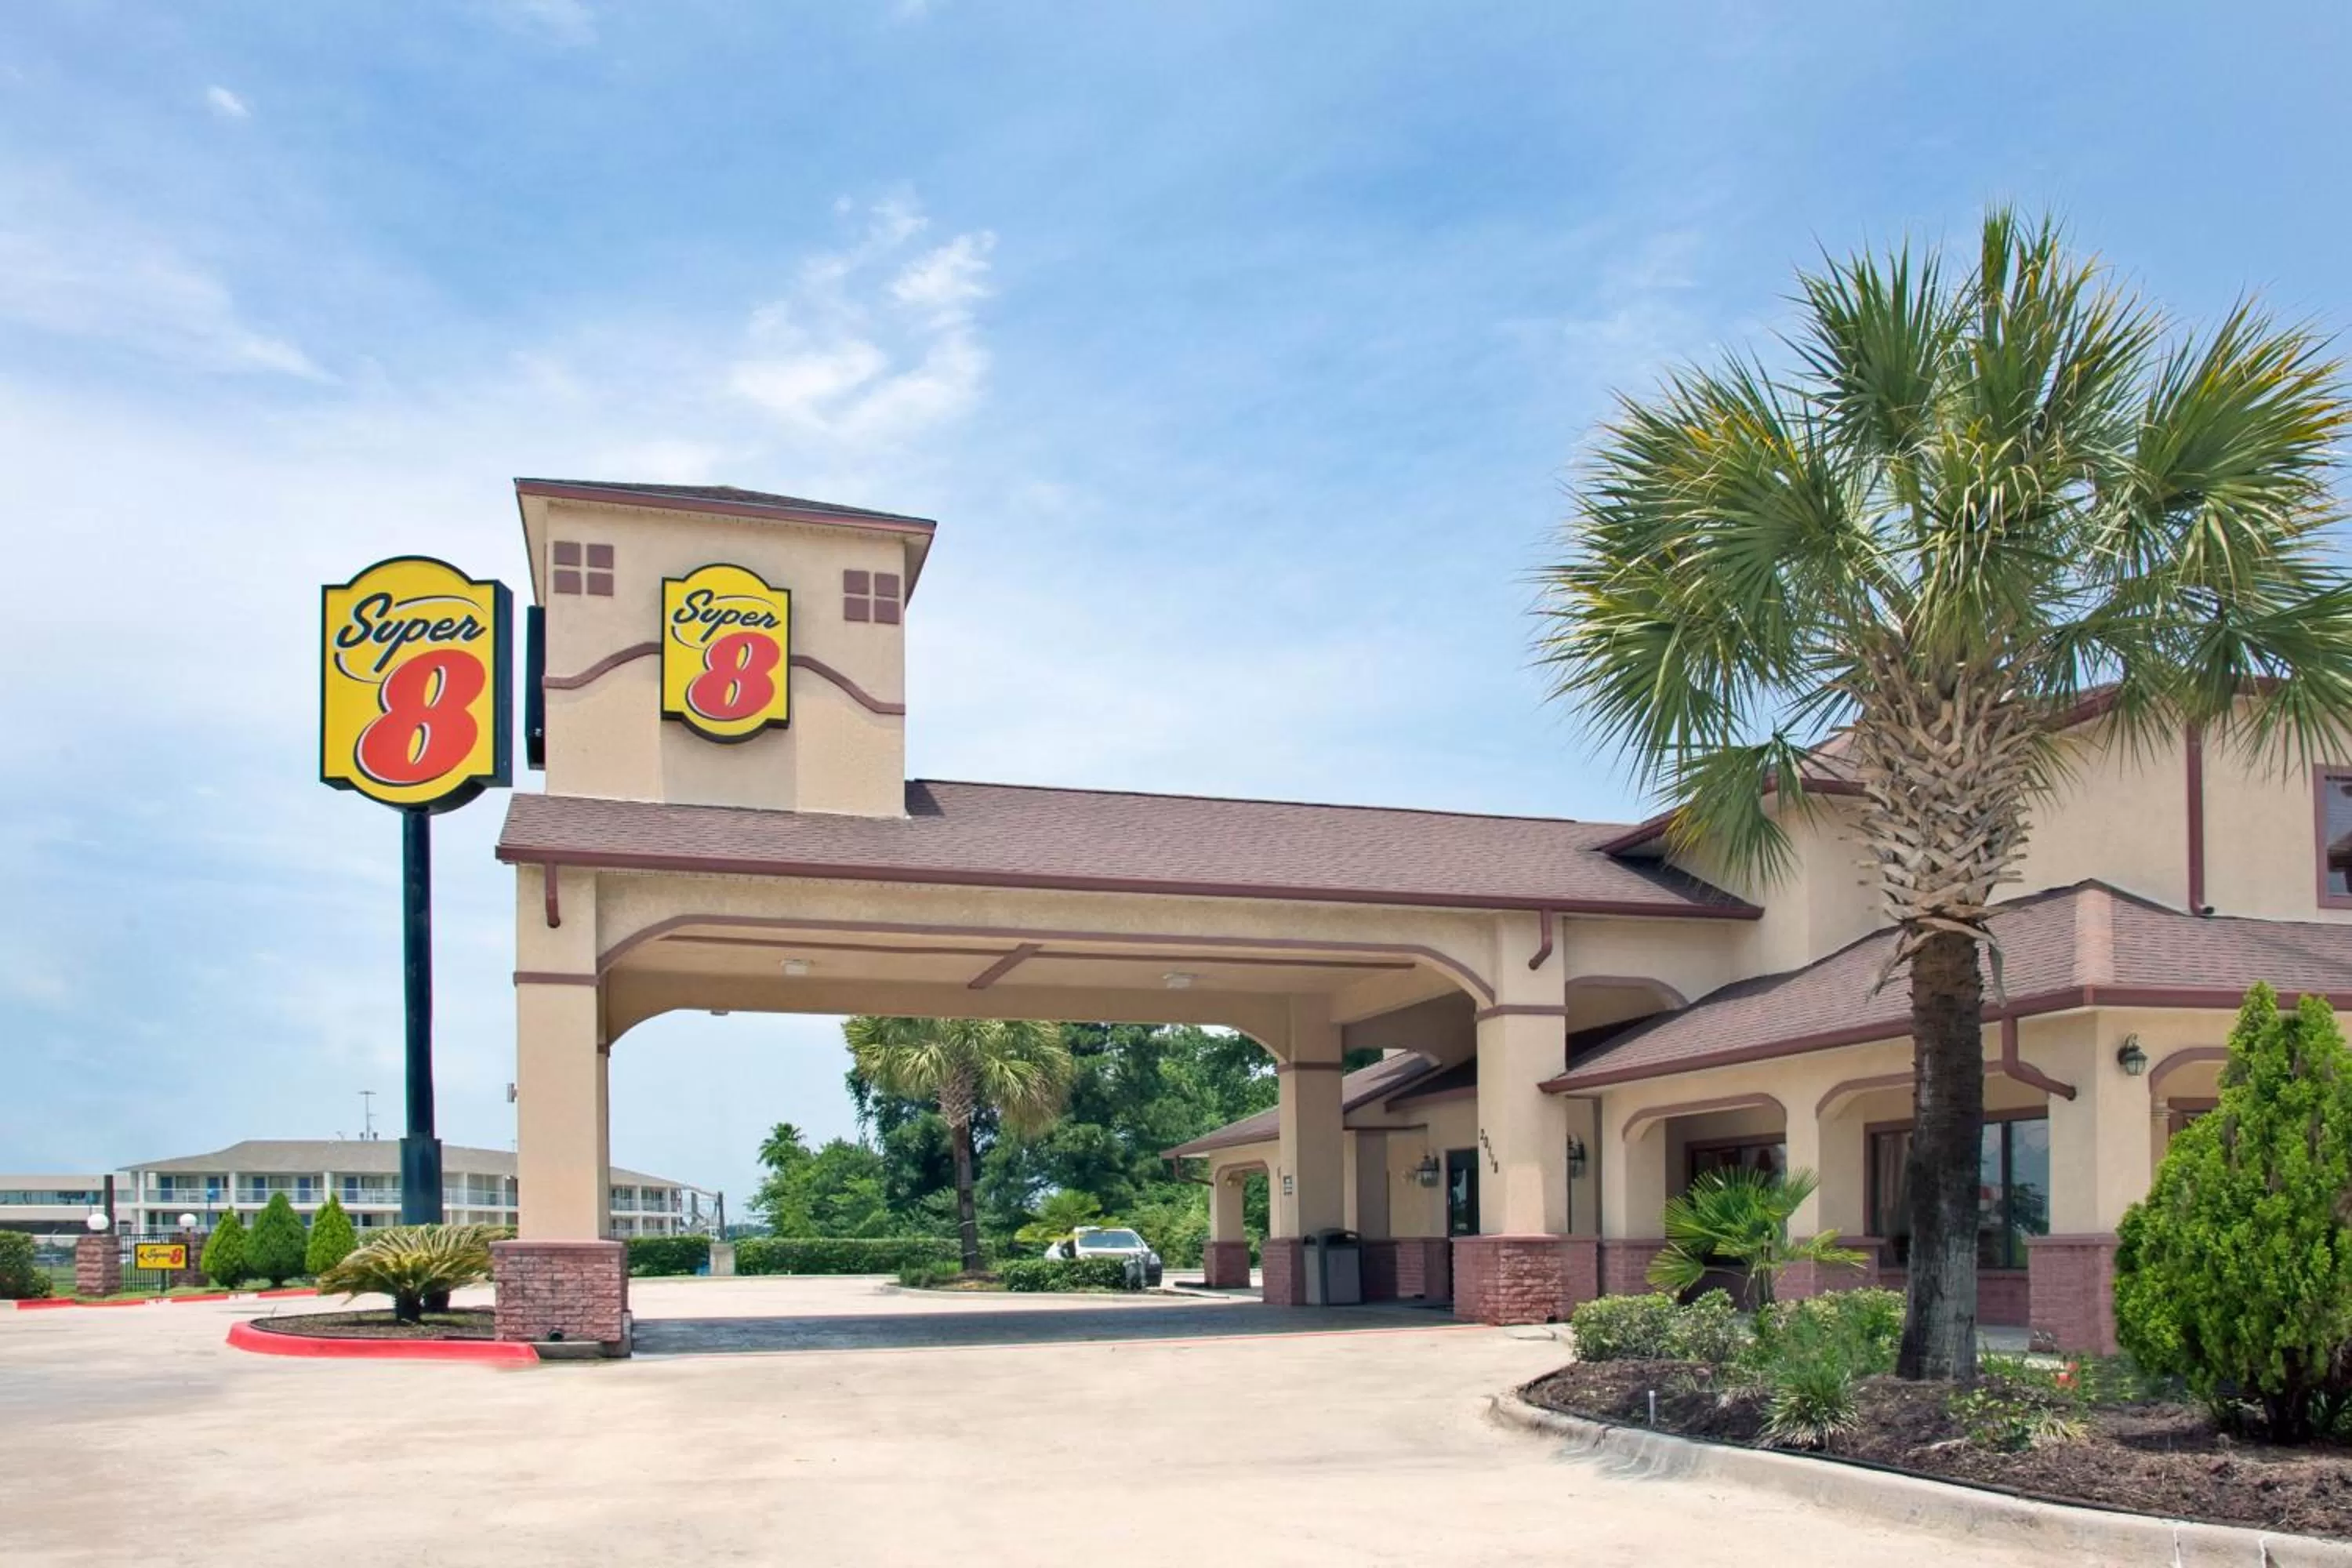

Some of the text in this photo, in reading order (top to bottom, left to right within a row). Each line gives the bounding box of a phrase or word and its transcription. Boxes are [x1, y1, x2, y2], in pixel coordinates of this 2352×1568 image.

[336, 592, 486, 673] Super
[673, 589, 781, 643] Super
[354, 649, 486, 787] 8
[685, 631, 780, 720] 8
